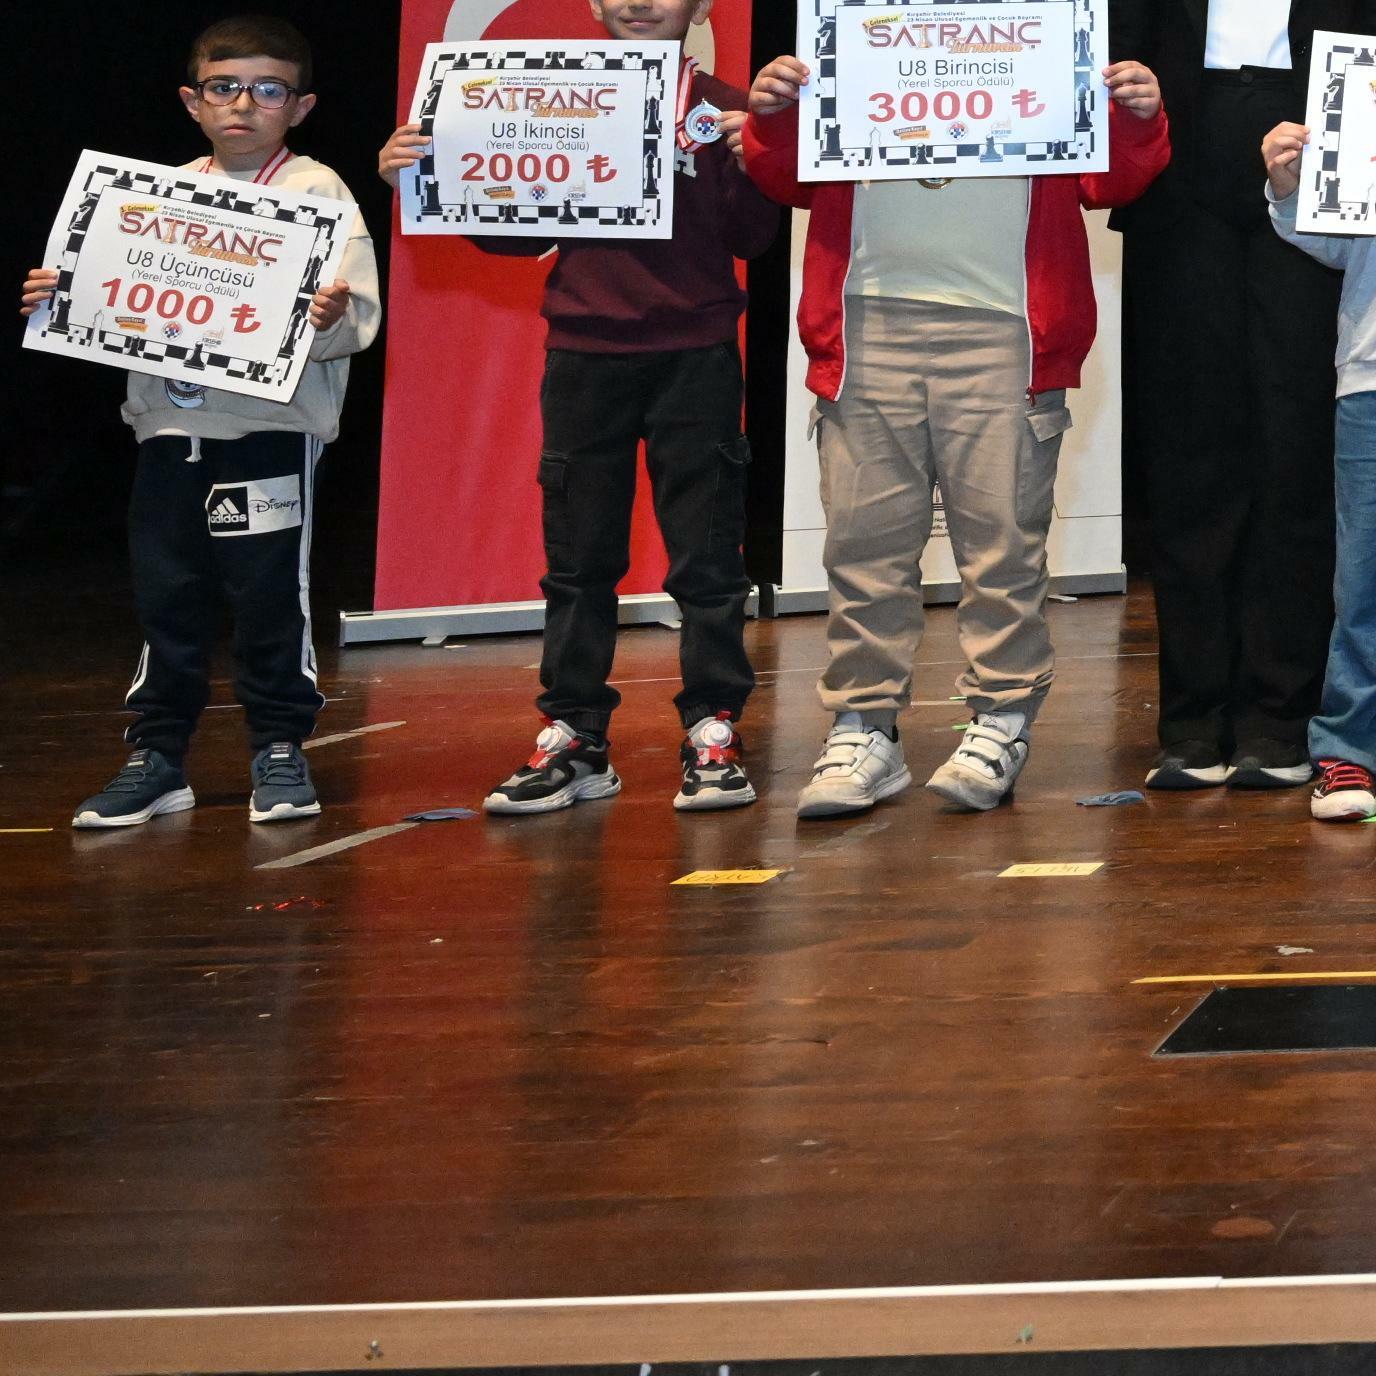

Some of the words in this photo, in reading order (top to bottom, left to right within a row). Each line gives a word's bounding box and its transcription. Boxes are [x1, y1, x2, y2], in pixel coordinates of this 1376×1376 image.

[867, 21, 1042, 52] SATRANÇ
[898, 60, 927, 77] U8
[935, 57, 1013, 76] Birincisi
[897, 78, 930, 90] (Yerel
[933, 78, 973, 89] Sporcu
[463, 86, 617, 116] SATRANÇ
[867, 89, 993, 123] 3000
[492, 122, 517, 139] U8
[524, 119, 585, 139] İkincisi
[485, 140, 515, 151] (Yerel
[519, 140, 553, 151] Sporcu
[460, 152, 570, 183] 2000
[119, 208, 283, 267] SATRANÇ
[126, 247, 154, 268] U8
[159, 252, 255, 289] Üçüncüsü
[131, 268, 163, 283] (Yerel
[164, 275, 202, 291] Sporcu
[101, 277, 214, 325] 1000
[210, 512, 247, 524] adidas
